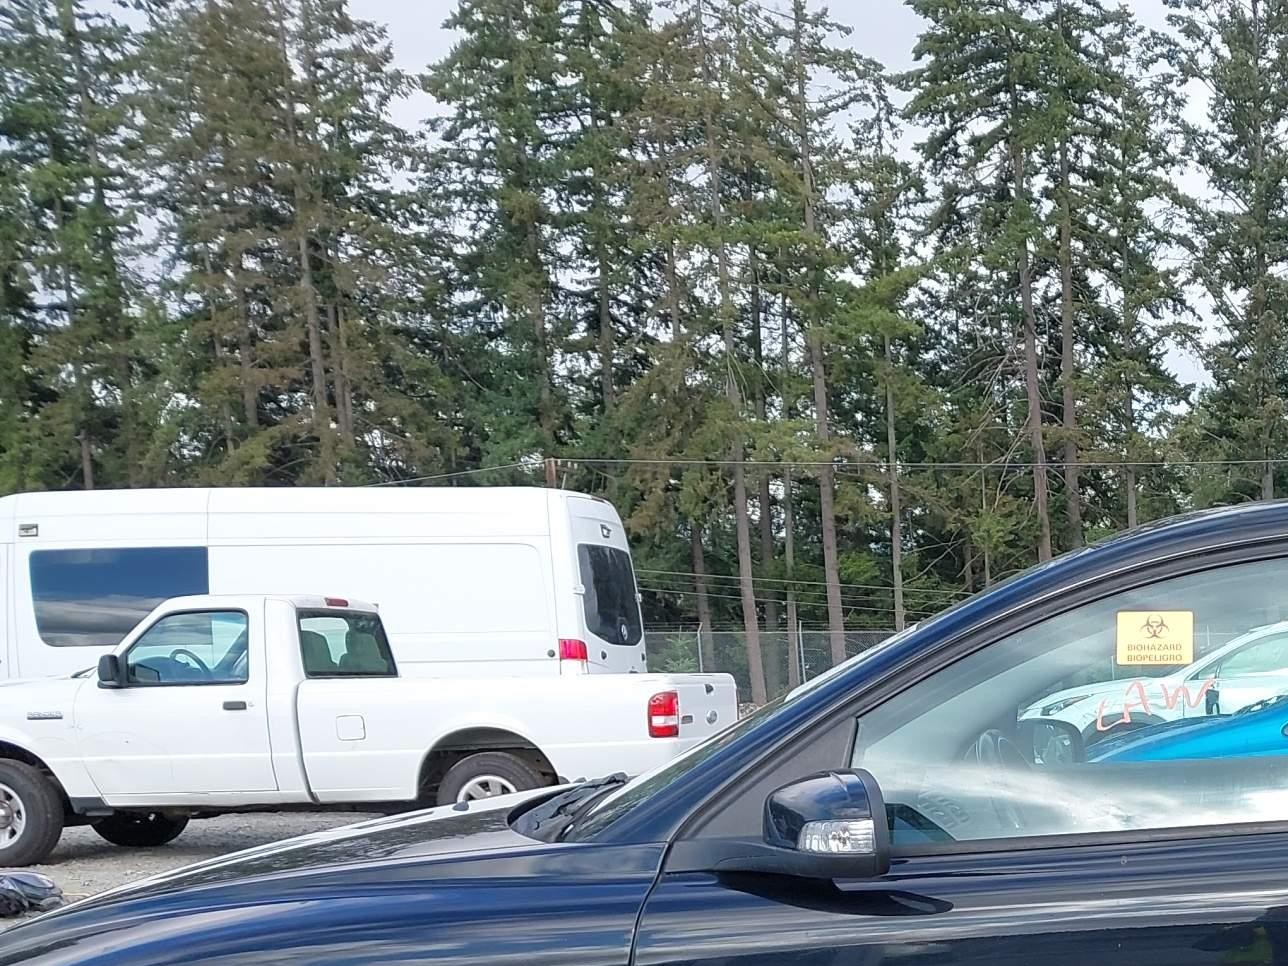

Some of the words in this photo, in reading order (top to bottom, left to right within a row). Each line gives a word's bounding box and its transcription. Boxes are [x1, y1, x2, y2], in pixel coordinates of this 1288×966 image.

[1127, 643, 1182, 651] BIOHAZARD
[1127, 654, 1183, 662] BIOPELIGRO
[1096, 678, 1217, 731] LAW
